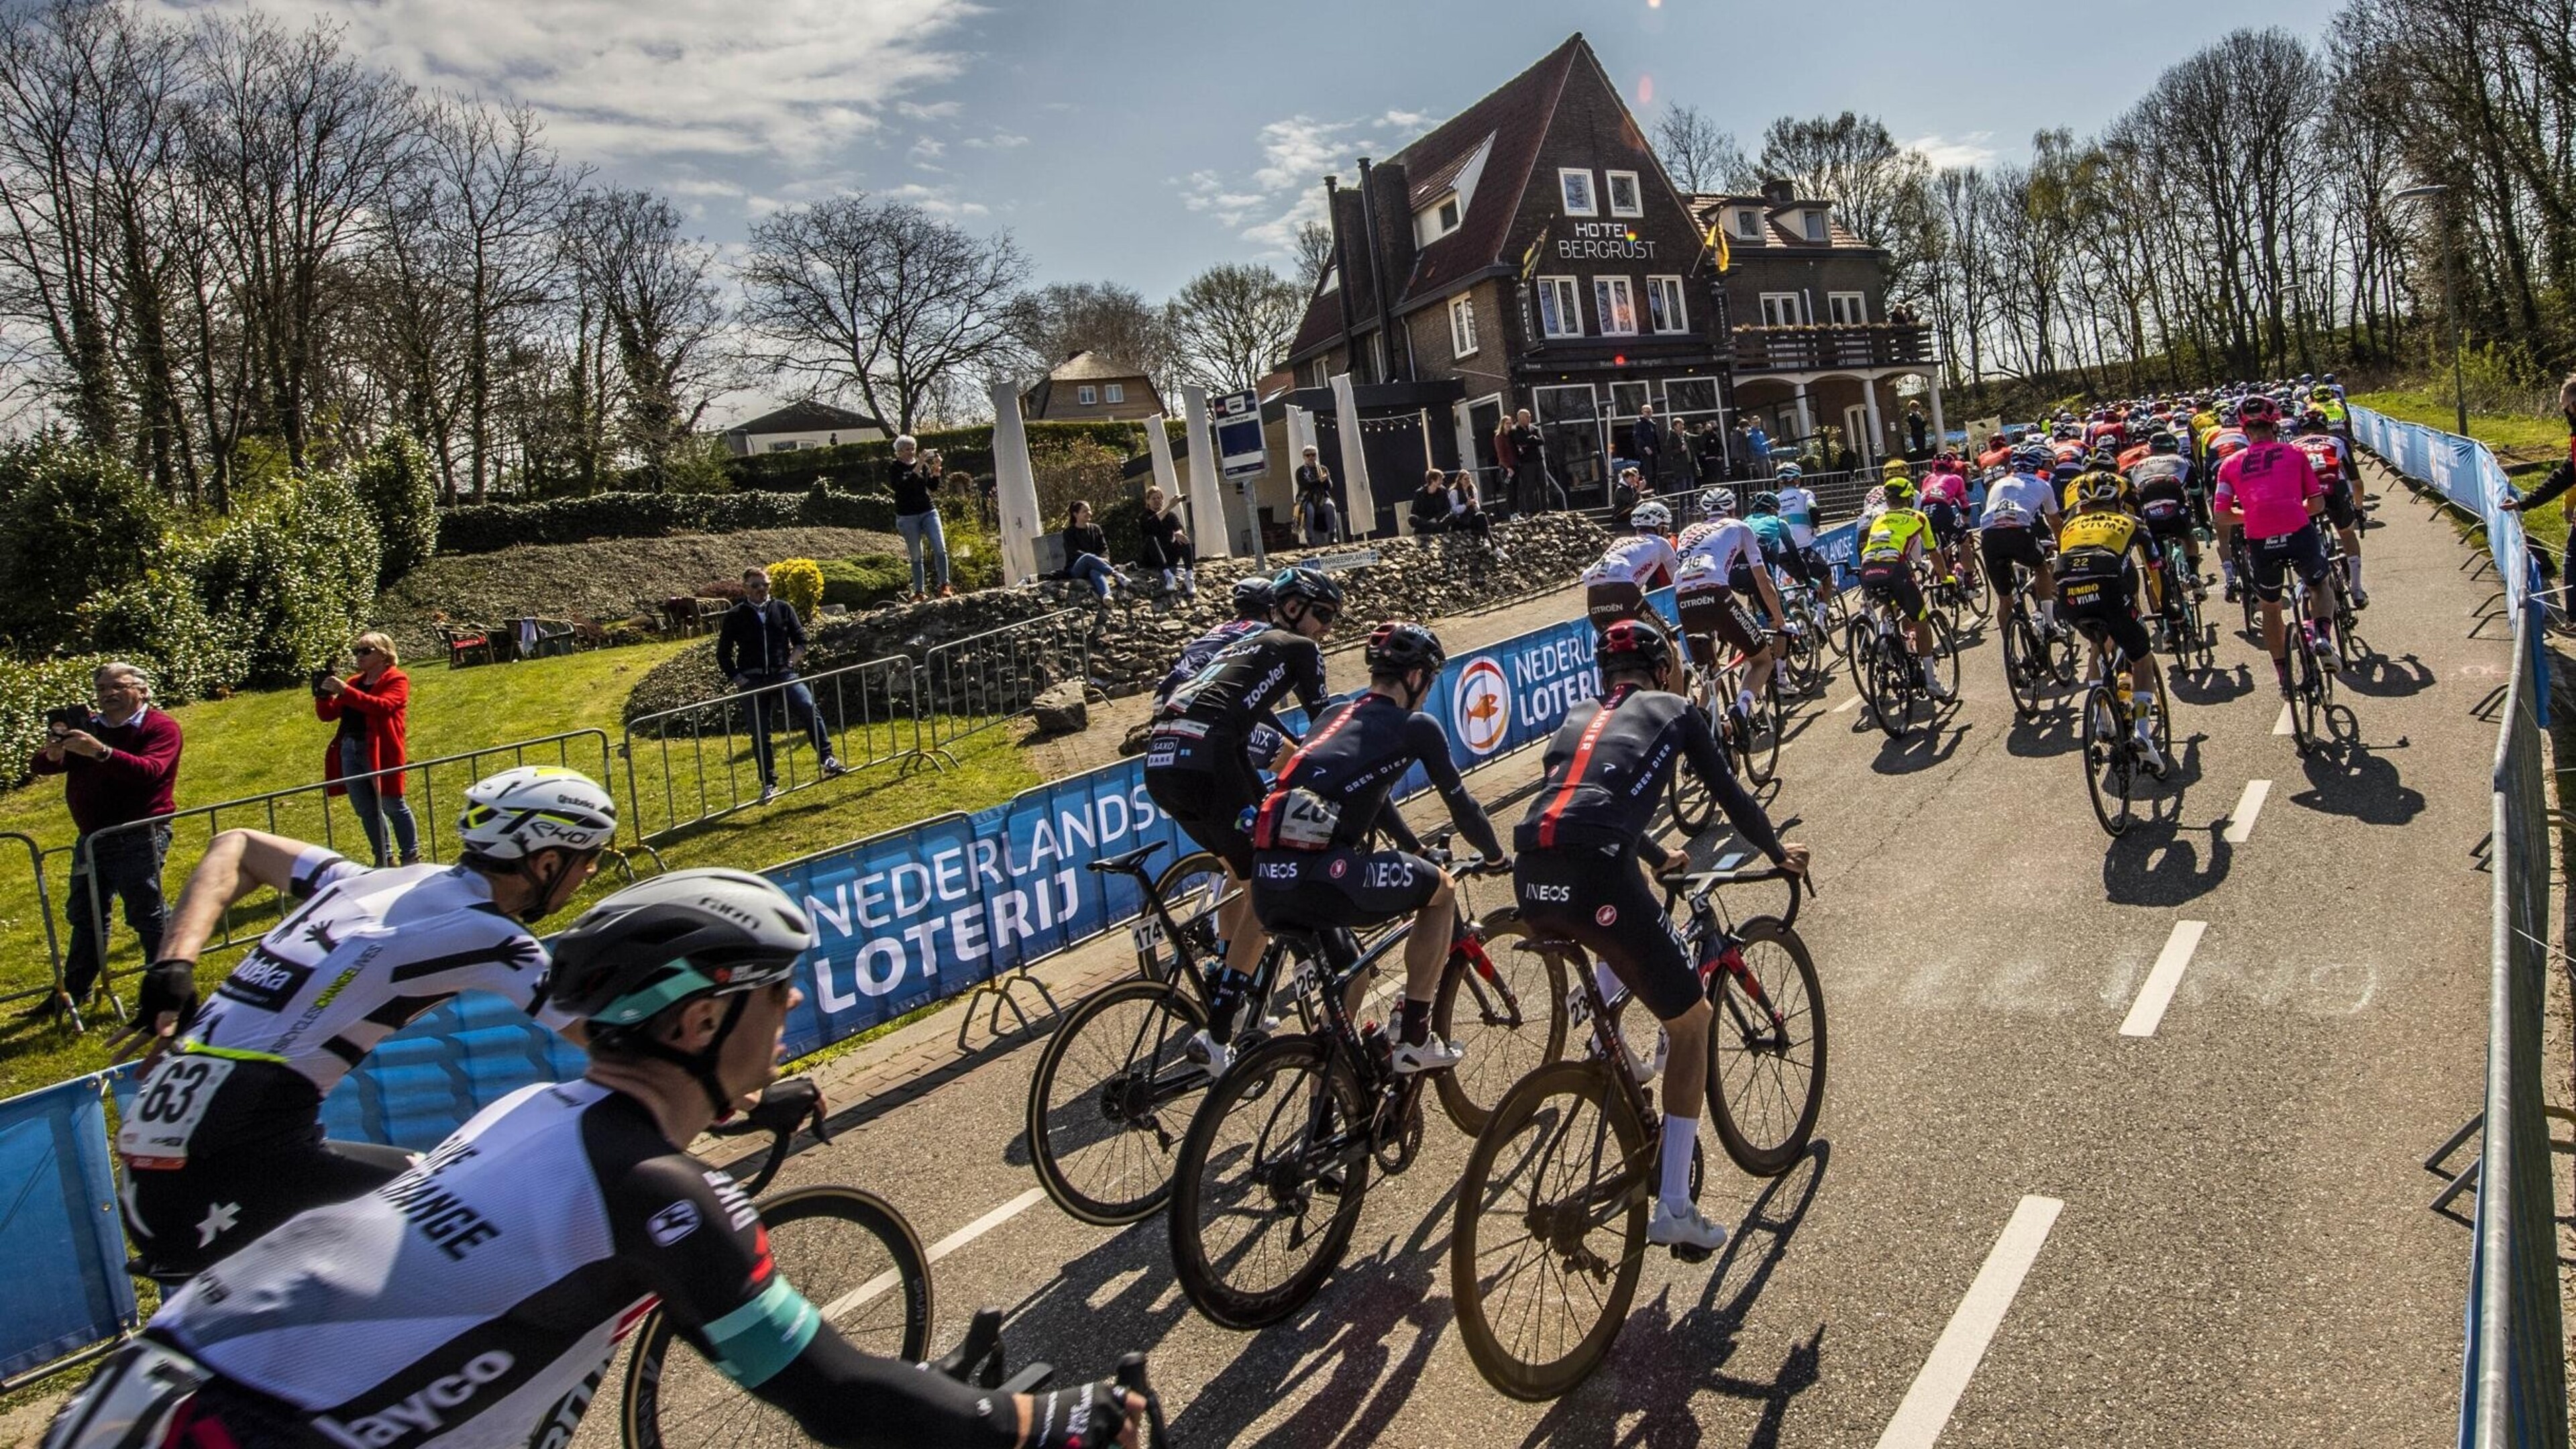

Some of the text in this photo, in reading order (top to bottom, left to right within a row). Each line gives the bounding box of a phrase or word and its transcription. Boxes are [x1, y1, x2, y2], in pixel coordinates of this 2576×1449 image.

[1575, 223, 1631, 237] HOTEL
[1558, 240, 1656, 259] BERGRUST
[1321, 552, 1370, 565] PARKEERPLAATS
[1679, 596, 1715, 609] CITROËN
[2067, 583, 2100, 596] JUMBO
[2076, 593, 2100, 605] VISMA
[1729, 605, 1762, 646] MONDIALE
[1515, 630, 1599, 688] NEDERLA
[1243, 662, 1286, 710] zoover
[1519, 666, 1605, 727] LOTERI
[1153, 741, 1175, 751] SAXO
[805, 783, 1172, 949] NEDERLANDS
[1258, 862, 1297, 878] INEOS
[1363, 862, 1413, 888] INEOS
[1525, 884, 1570, 902] INEOS
[814, 867, 1079, 1014] LOTERIJ
[1134, 922, 1162, 949] 174
[1296, 969, 1317, 998] 26
[140, 1061, 210, 1124] 63
